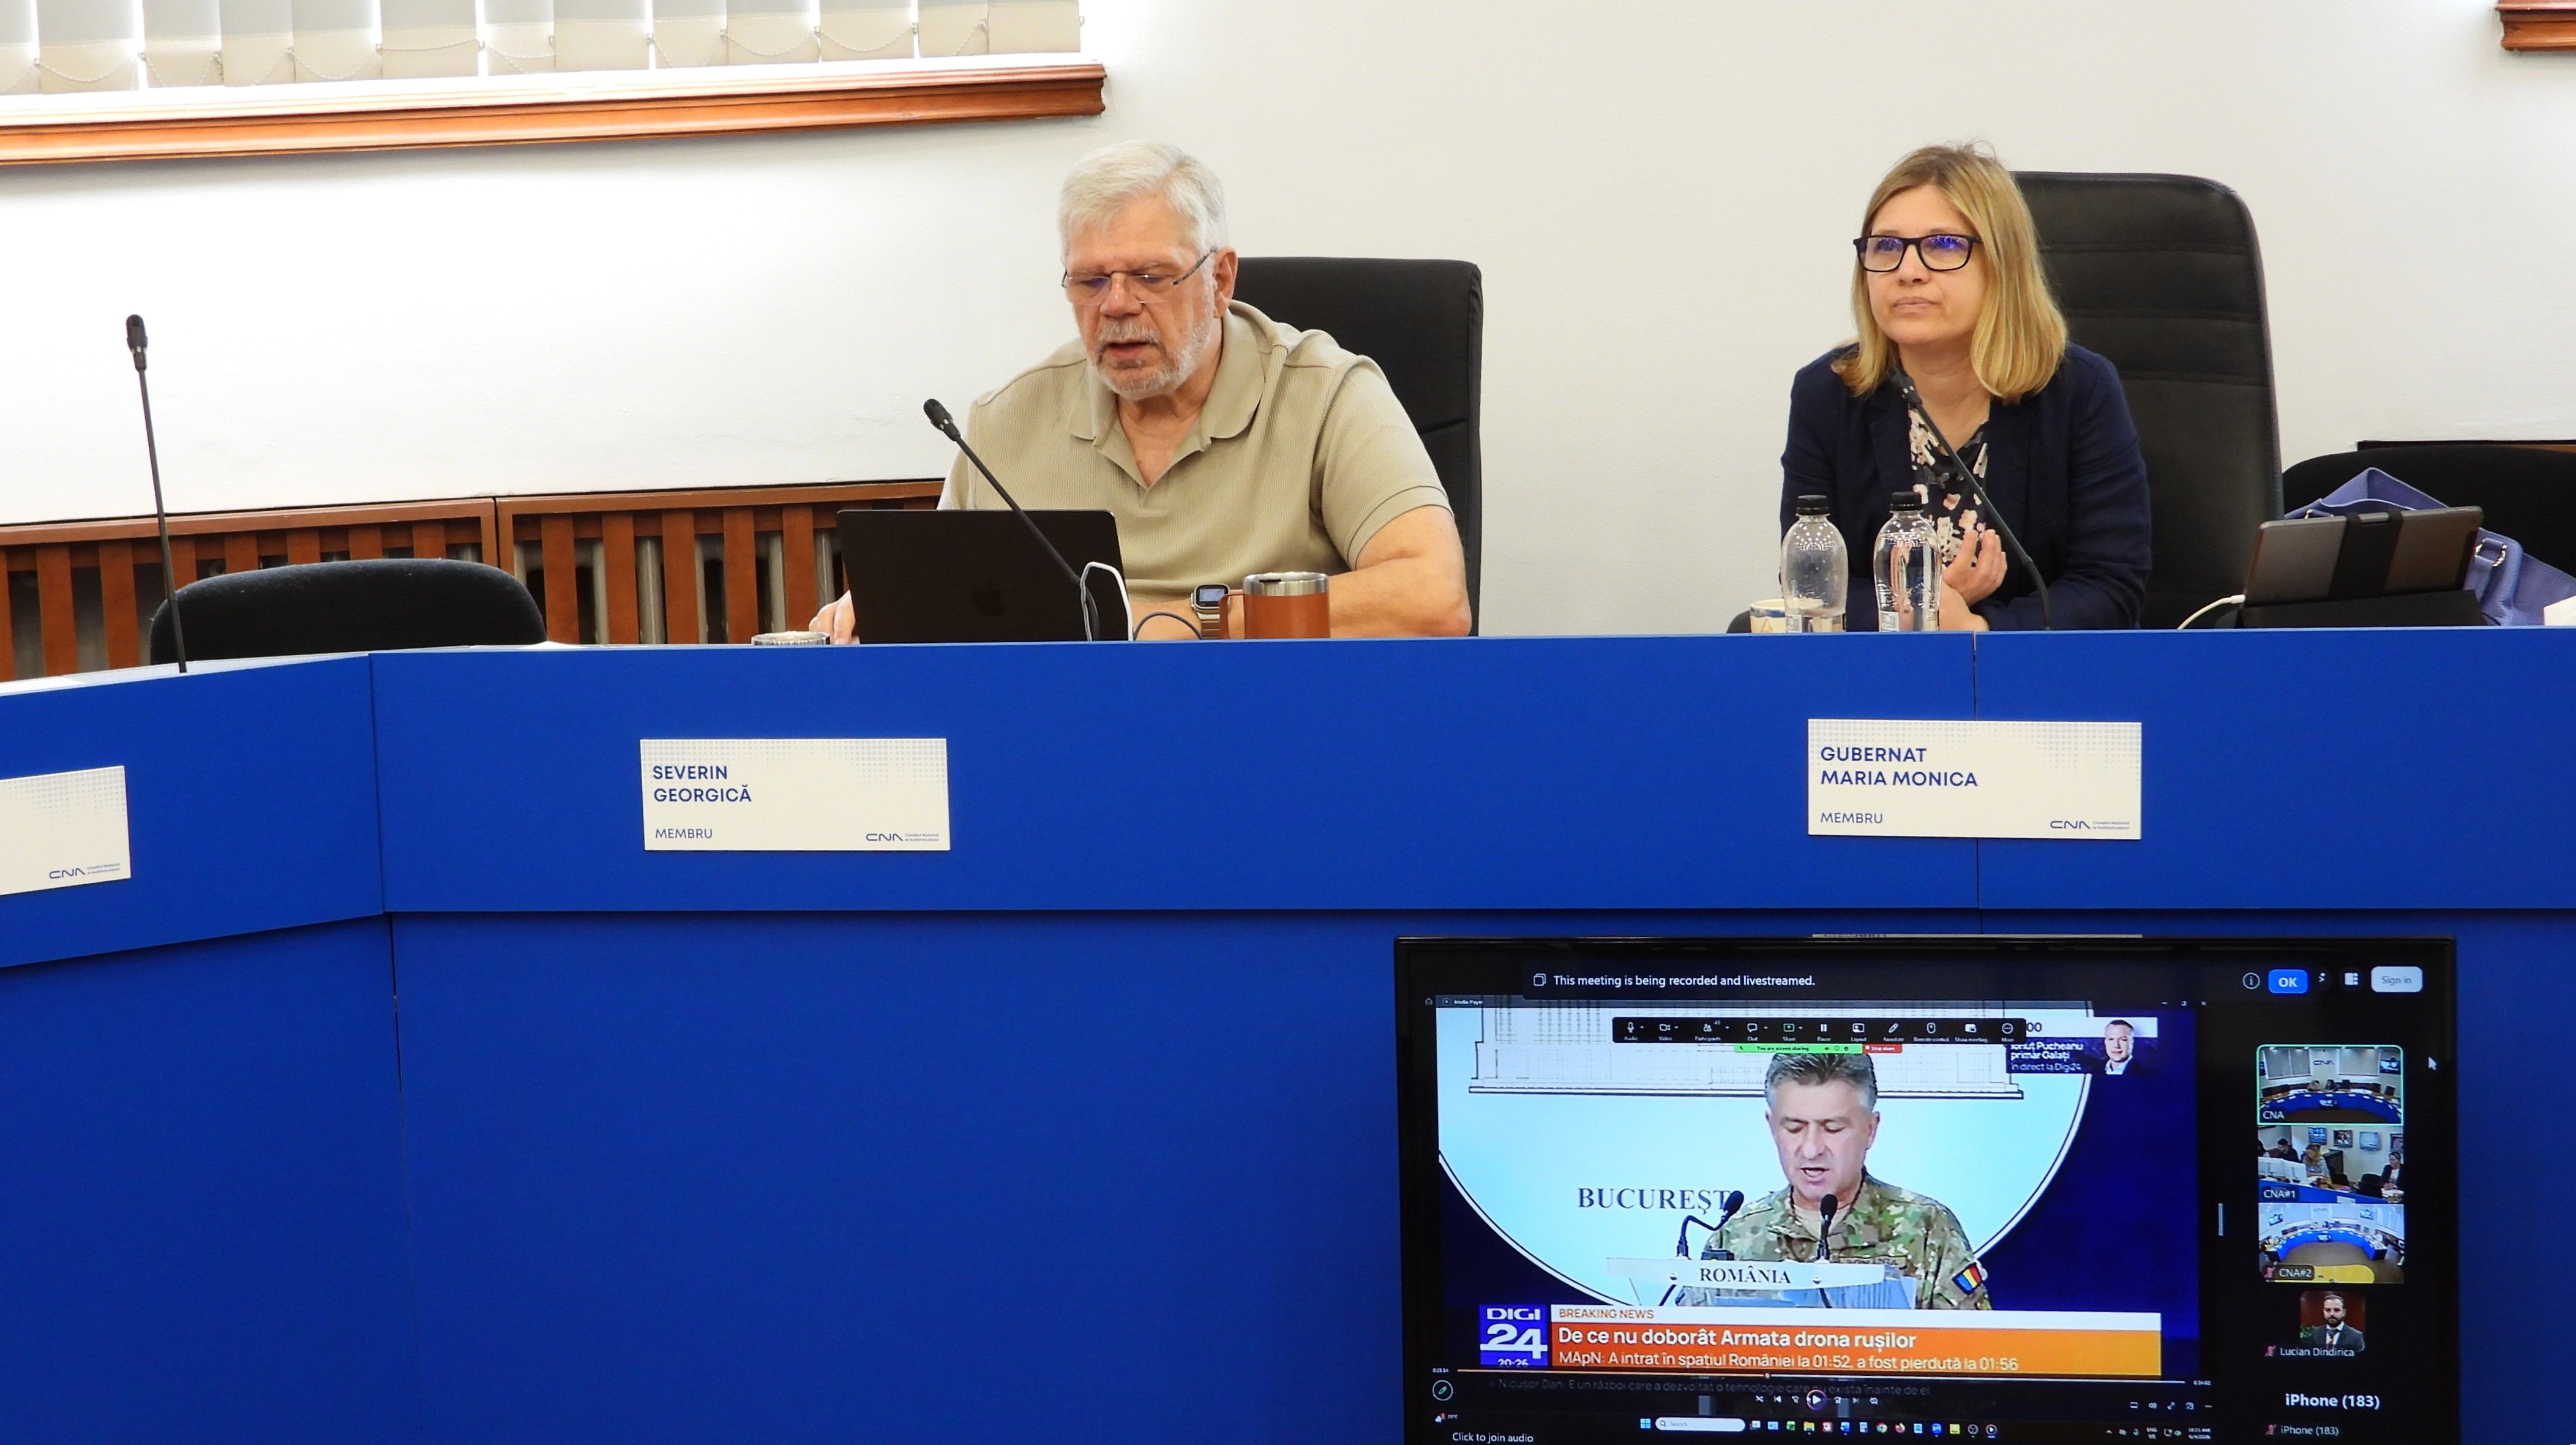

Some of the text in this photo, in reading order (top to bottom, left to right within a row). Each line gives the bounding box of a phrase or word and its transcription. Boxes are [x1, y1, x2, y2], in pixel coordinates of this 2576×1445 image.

[1821, 746, 1927, 763] GUBERNAT
[653, 765, 728, 779] SEVERIN
[1821, 770, 1978, 787] MARIA MONICA
[654, 784, 752, 802] GEORGICĂ
[1821, 813, 1883, 824] MEMBRU
[2050, 820, 2091, 829] CNA
[655, 828, 713, 839] MEMBRU
[49, 867, 86, 879] CNA
[1553, 975, 1816, 988] This meeting is being recorded and livestreamed.
[2278, 977, 2298, 988] OK
[2381, 975, 2412, 986] Sign in
[2262, 1111, 2285, 1119] CNA
[2263, 1189, 2296, 1198] CNA#1
[1699, 1265, 1791, 1284] ROMÂNIA
[2278, 1268, 2313, 1278] CNA#2
[1486, 1308, 1541, 1320] DIGI
[1559, 1308, 1654, 1318] BREAKING NEWS
[1480, 1323, 1548, 1359] 24
[1558, 1327, 1917, 1353] De ce nu doborât Armata drona rușilor
[2280, 1347, 2355, 1357] Lucian Dindirica
[1559, 1351, 1605, 1366] MApN:
[1608, 1352, 1619, 1364] A
[1621, 1351, 1660, 1365] intrat
[1662, 1351, 1676, 1365] în
[1678, 1353, 1726, 1368] spațiul
[1729, 1353, 1794, 1367] României
[1797, 1355, 1810, 1367] la
[1856, 1357, 1866, 1368] a
[1868, 1355, 1898, 1369] fost
[1900, 1356, 1961, 1372] pierdută
[1964, 1357, 1977, 1370] la
[1979, 1357, 2018, 1371] 01:56
[2285, 1393, 2380, 1409] iPhone (183)
[2280, 1425, 2340, 1436] iPhone (183)
[1452, 1432, 1474, 1441] Click
[1487, 1433, 1506, 1444] join
[1507, 1433, 1534, 1443] audio
